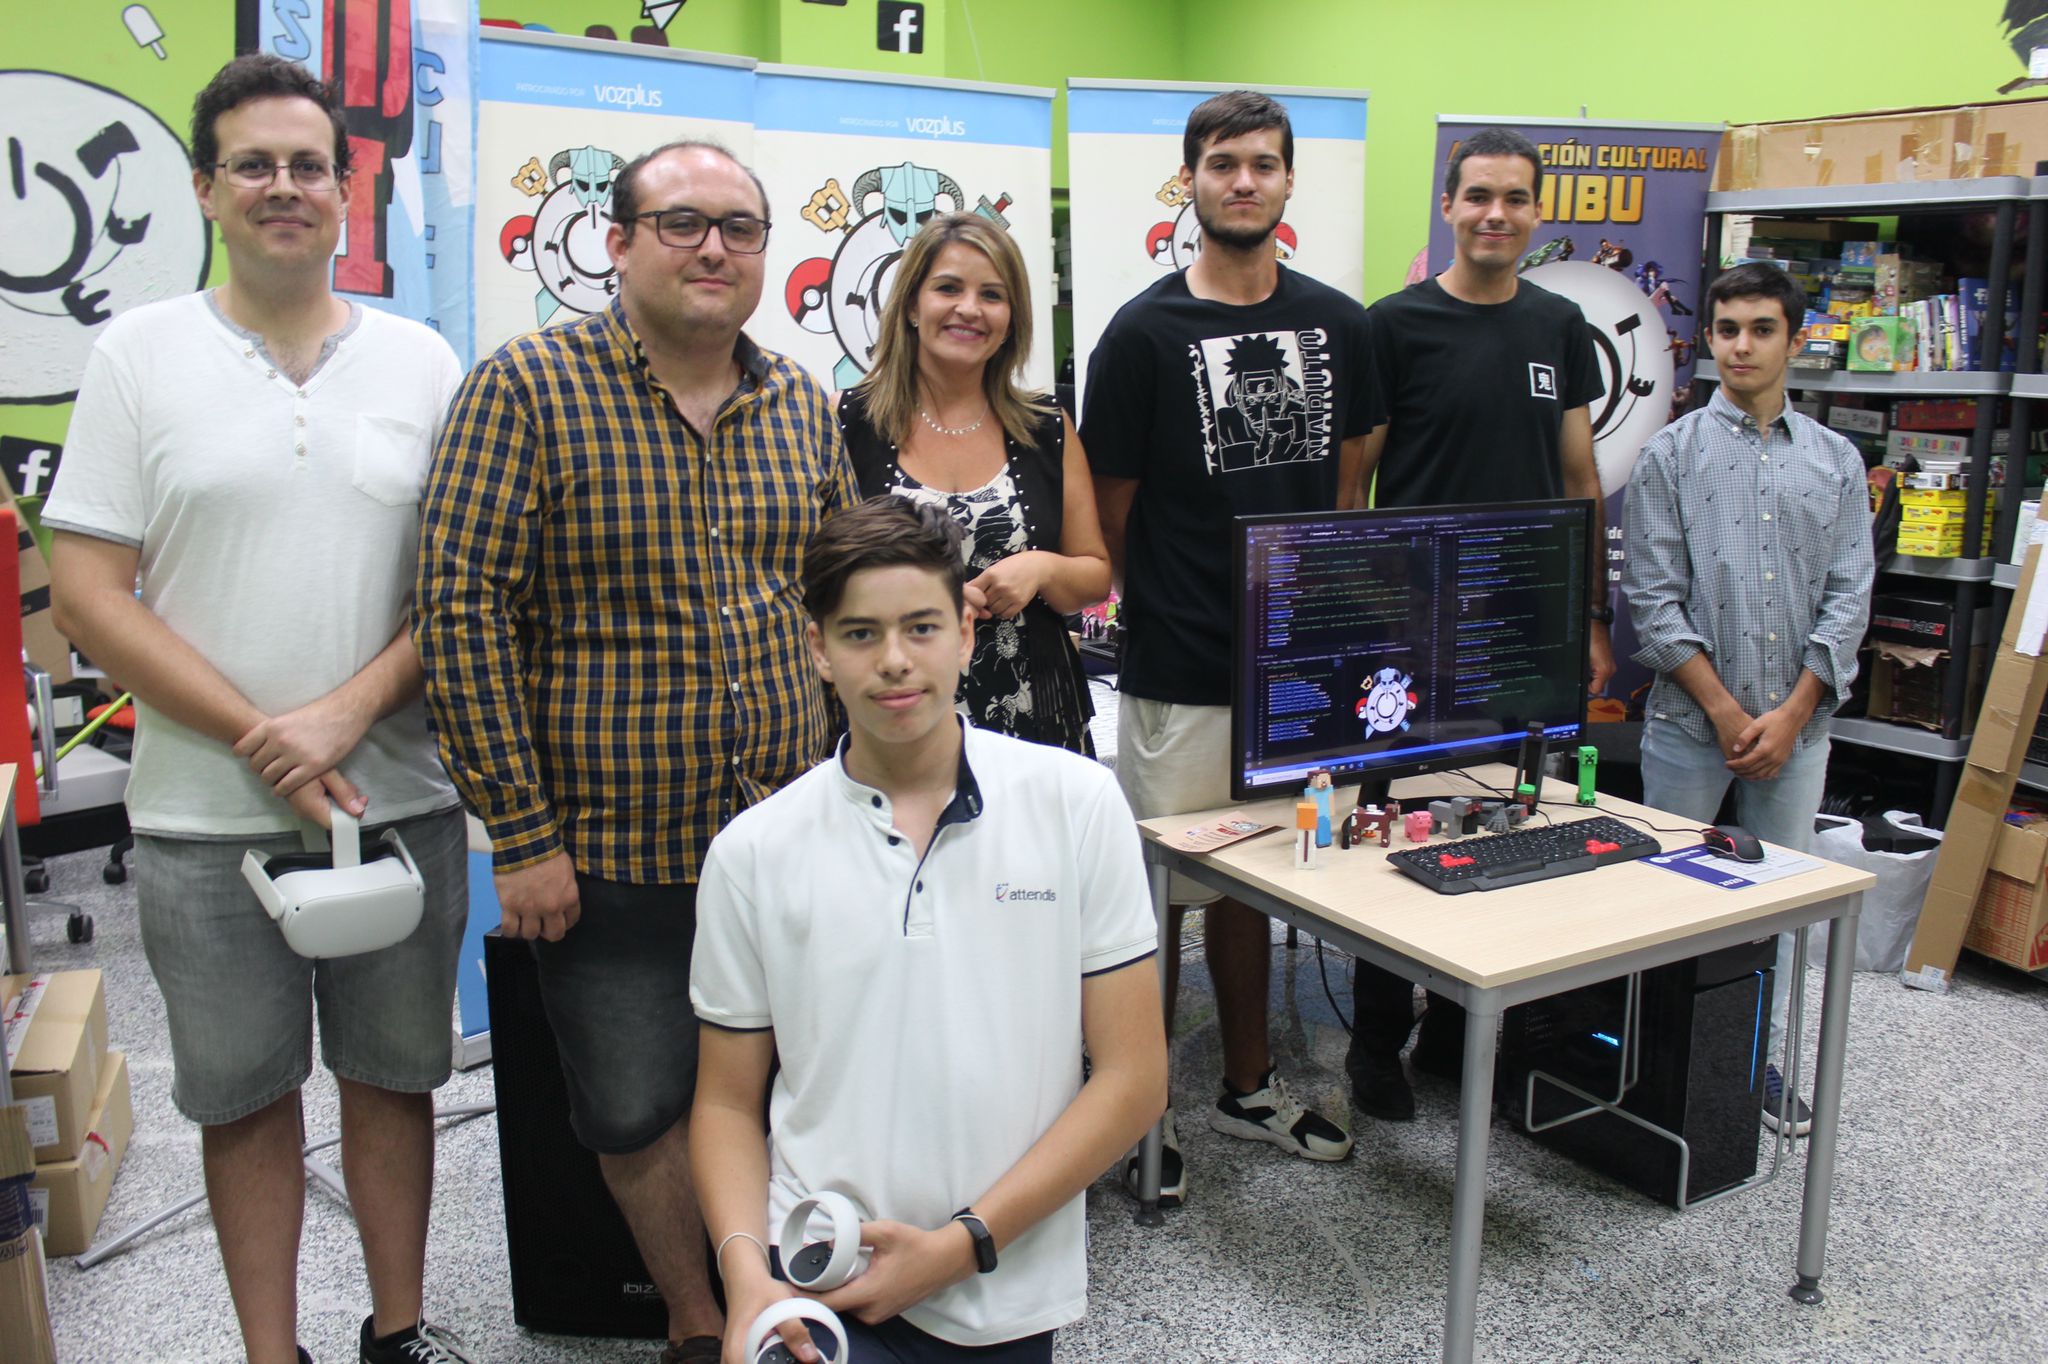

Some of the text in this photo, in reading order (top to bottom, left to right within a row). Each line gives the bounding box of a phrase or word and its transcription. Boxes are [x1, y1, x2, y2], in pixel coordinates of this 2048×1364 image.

[593, 83, 663, 110] vozplus
[905, 115, 966, 138] vozplus
[1538, 138, 1708, 172] CIÓN CULTURAL
[1297, 328, 1333, 461] NARUTO
[623, 1282, 659, 1294] ibiz
